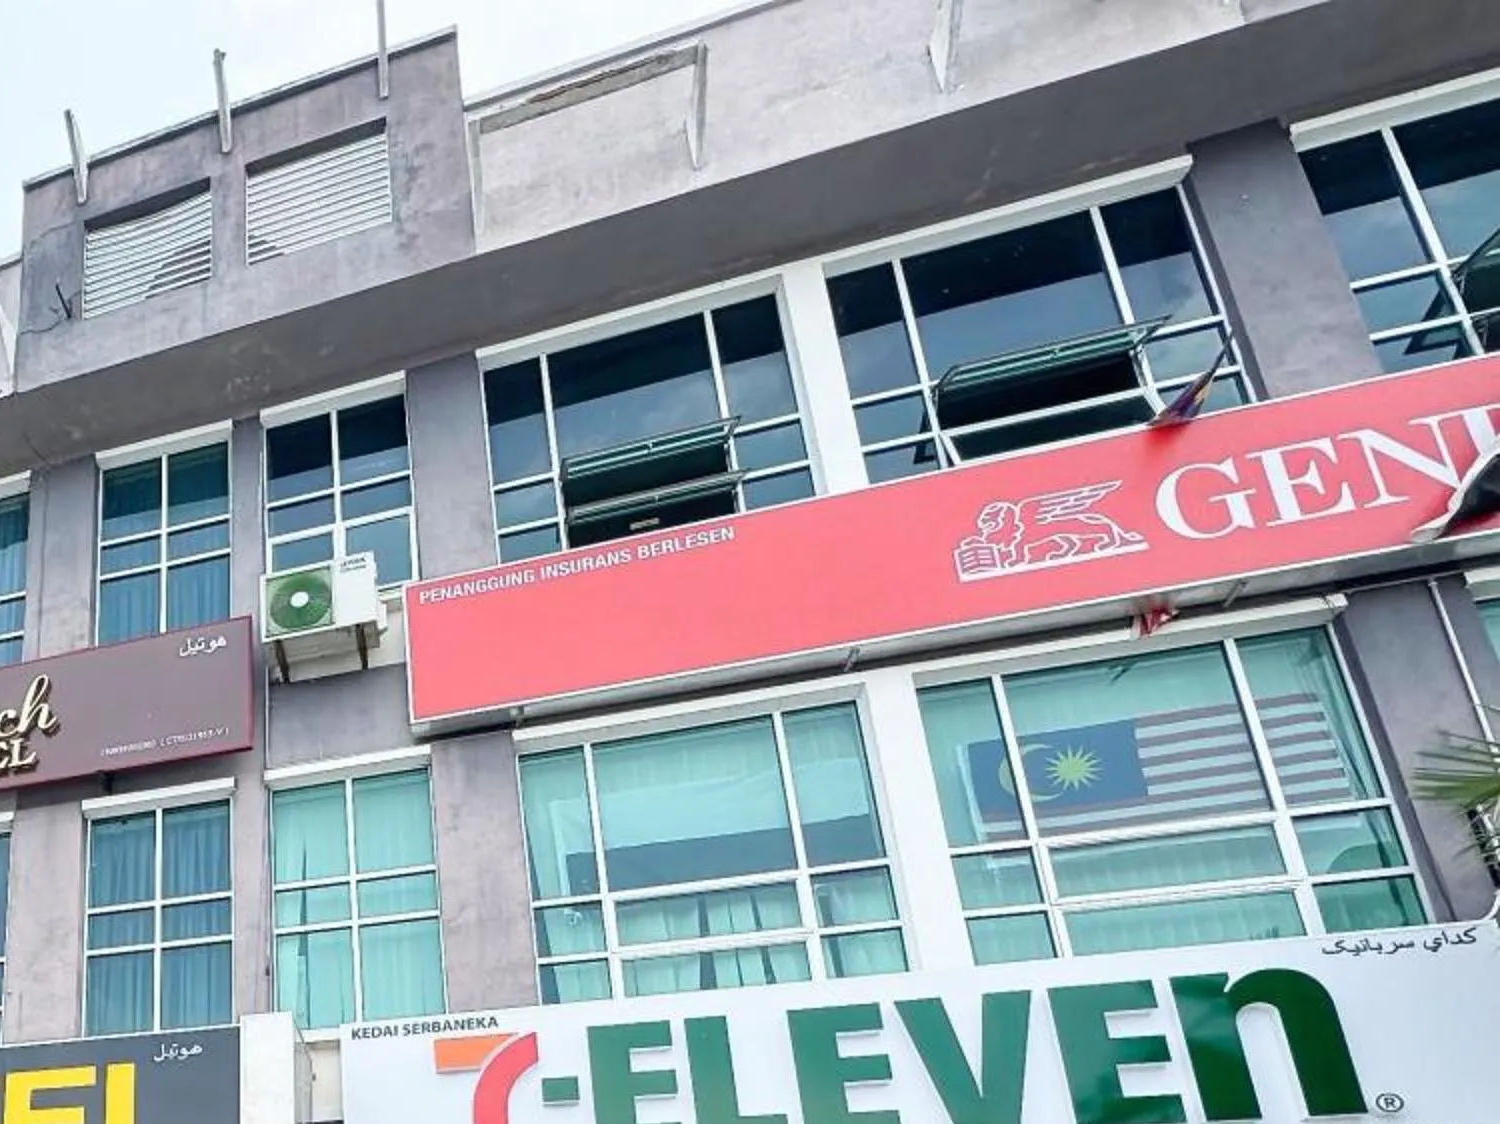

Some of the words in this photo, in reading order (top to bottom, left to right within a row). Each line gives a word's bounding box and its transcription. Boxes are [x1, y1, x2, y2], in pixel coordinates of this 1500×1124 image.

[419, 567, 535, 604] PENANGGUNG
[540, 548, 632, 581] INSURANS
[637, 525, 735, 560] BERLESEN
[180, 636, 228, 657] هوتيل
[350, 1026, 399, 1041] KEDAI
[402, 1016, 499, 1037] SERBANEKA
[153, 1043, 203, 1062] هوتيل
